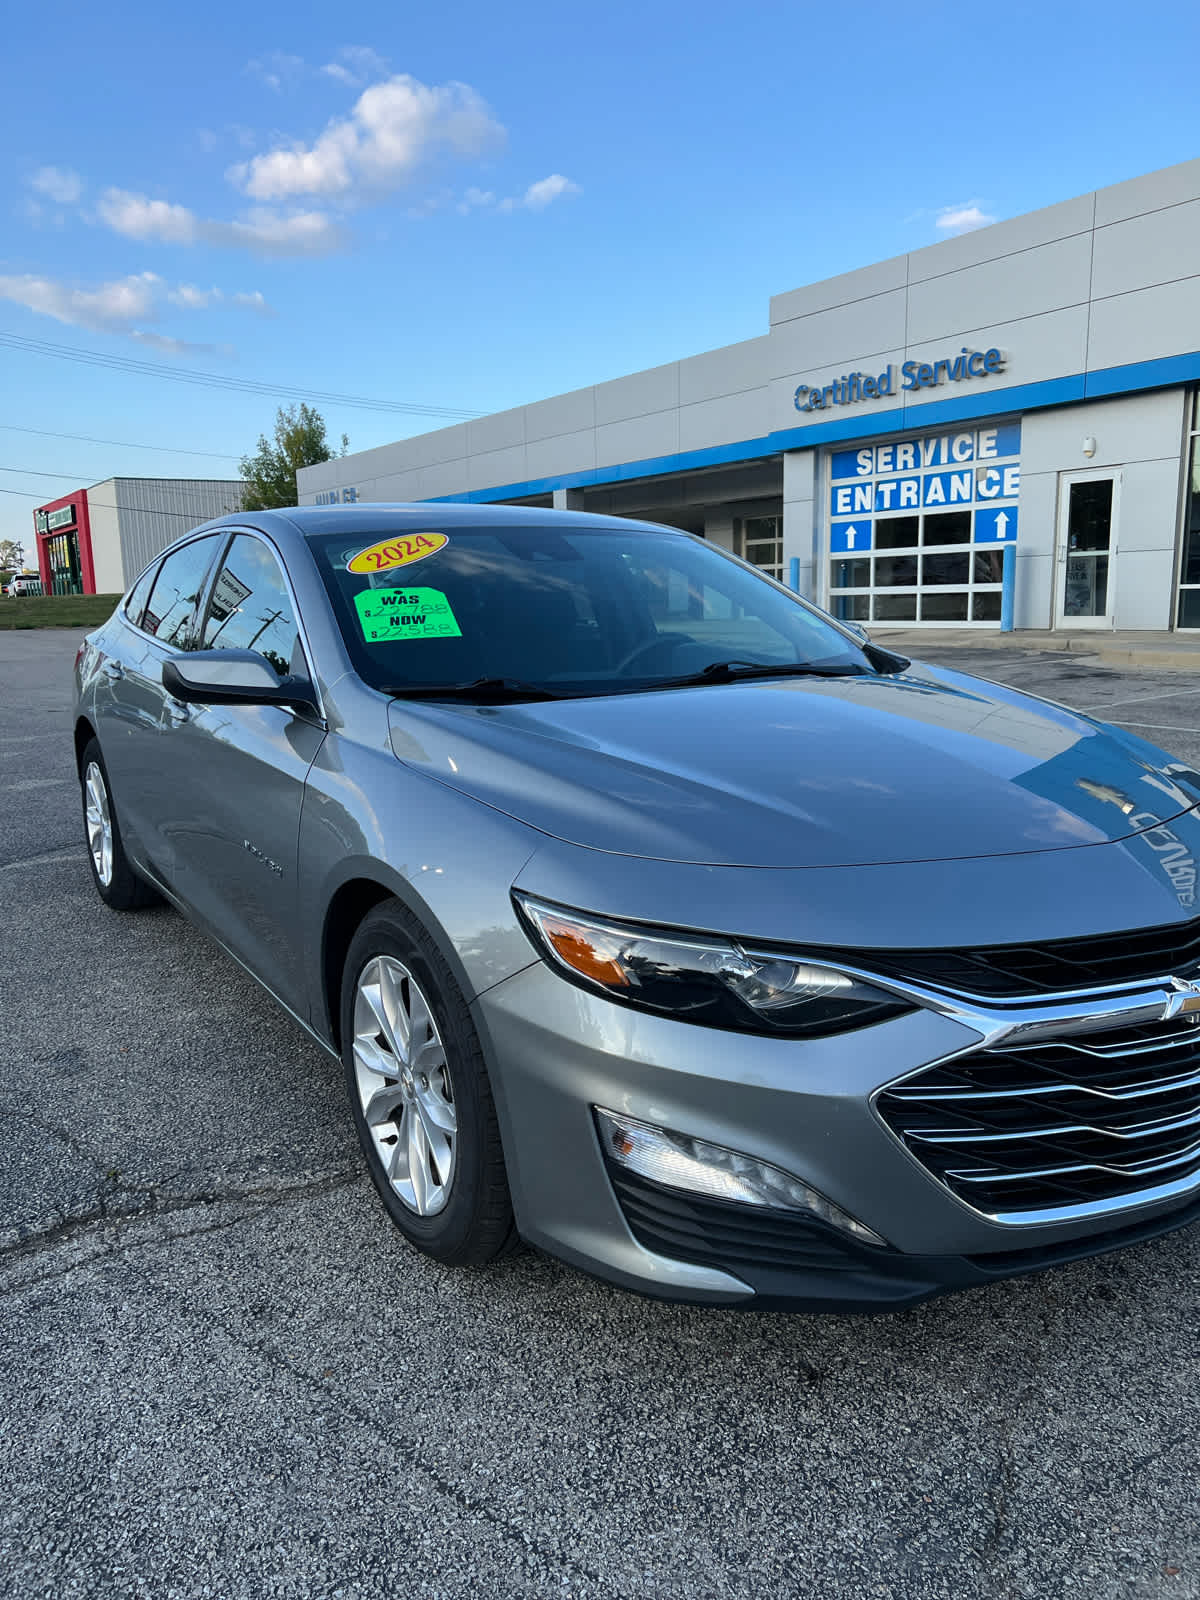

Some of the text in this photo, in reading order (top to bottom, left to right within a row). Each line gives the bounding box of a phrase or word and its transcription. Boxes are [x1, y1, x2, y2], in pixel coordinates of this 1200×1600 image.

[794, 346, 1004, 413] Certified Service
[856, 429, 999, 477] SERVICE
[836, 466, 1021, 514] ENTRANCE
[366, 535, 435, 569] 2024
[381, 595, 420, 606] WAS
[389, 615, 427, 626] NOW
